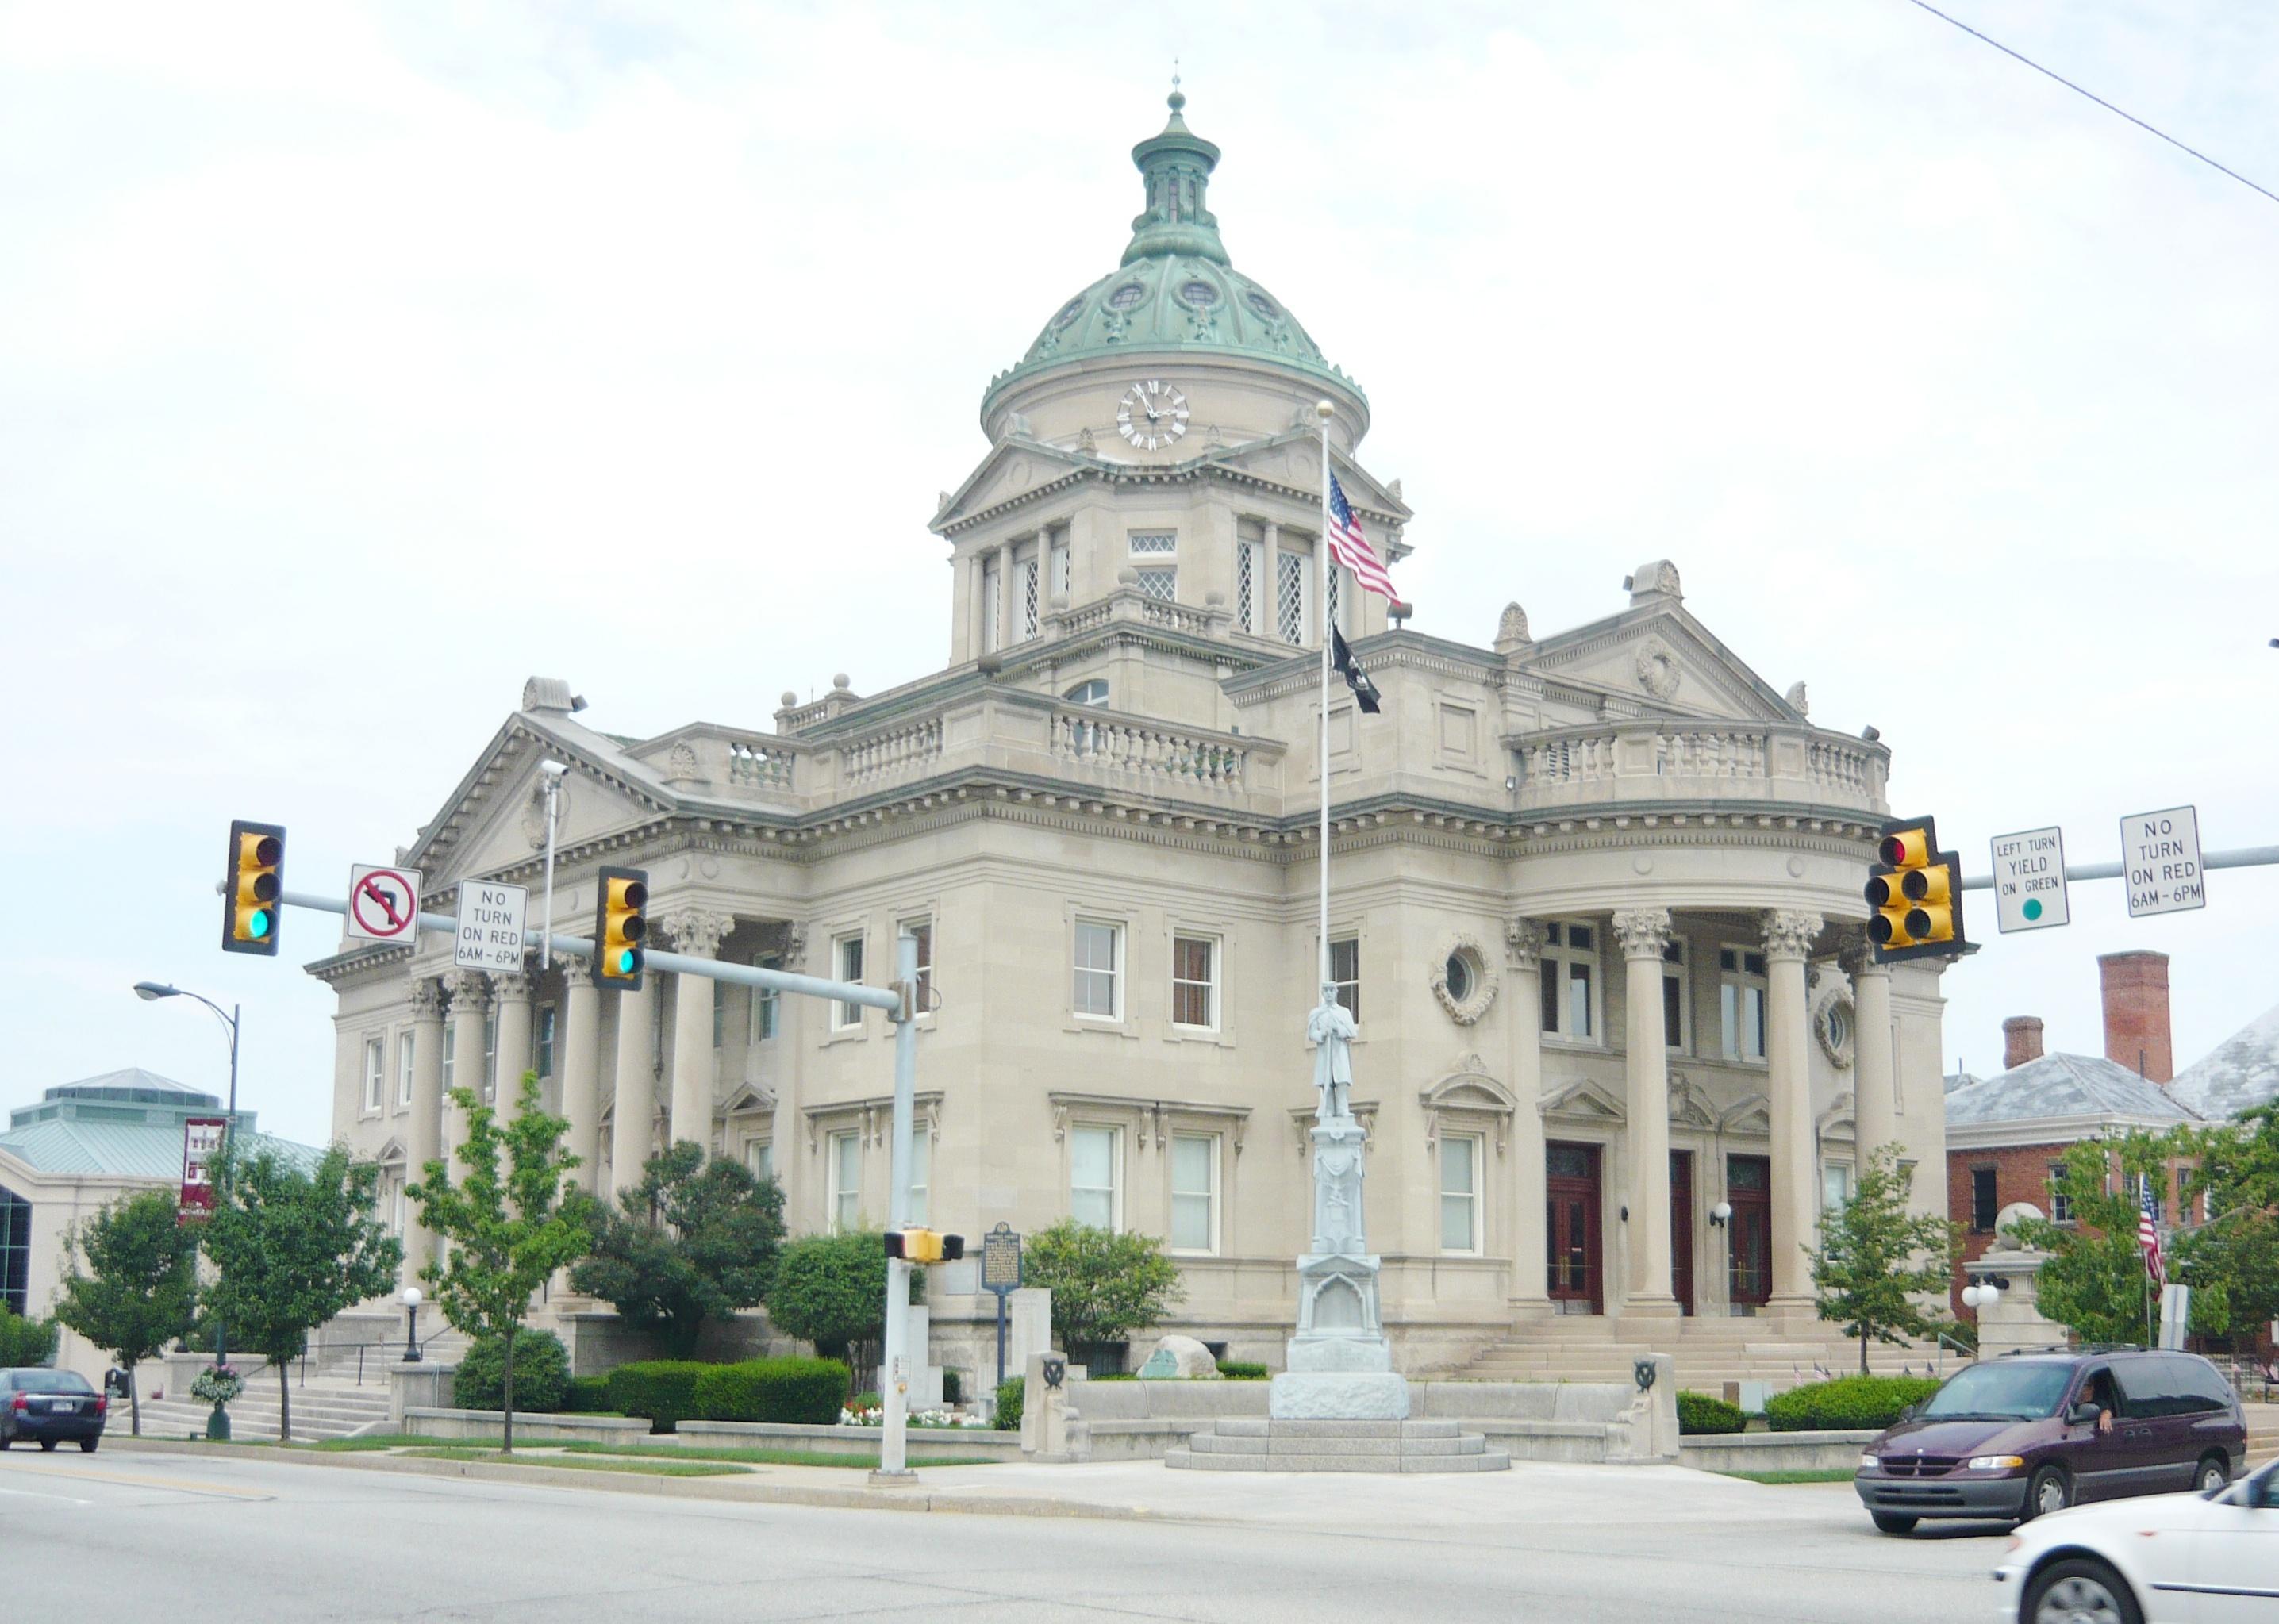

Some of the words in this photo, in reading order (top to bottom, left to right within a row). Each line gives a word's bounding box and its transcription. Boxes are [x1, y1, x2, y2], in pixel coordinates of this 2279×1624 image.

[2144, 820, 2172, 838] NO
[1997, 842, 2021, 857] LEFT
[2028, 835, 2056, 851] TURN
[2139, 839, 2184, 861] TURN
[2009, 857, 2047, 876] YIELD
[2131, 867, 2154, 885] ON
[2162, 862, 2195, 881] RED
[2002, 882, 2016, 896] ON
[2025, 876, 2058, 893] GREEN
[2131, 889, 2159, 908] 6AM
[2173, 883, 2201, 902] 6PM
[482, 890, 506, 905] NO
[474, 908, 513, 925] TURN
[463, 927, 482, 942] ON
[490, 930, 518, 946] RED
[459, 946, 483, 961] 6AM
[496, 950, 520, 965] 6PM
